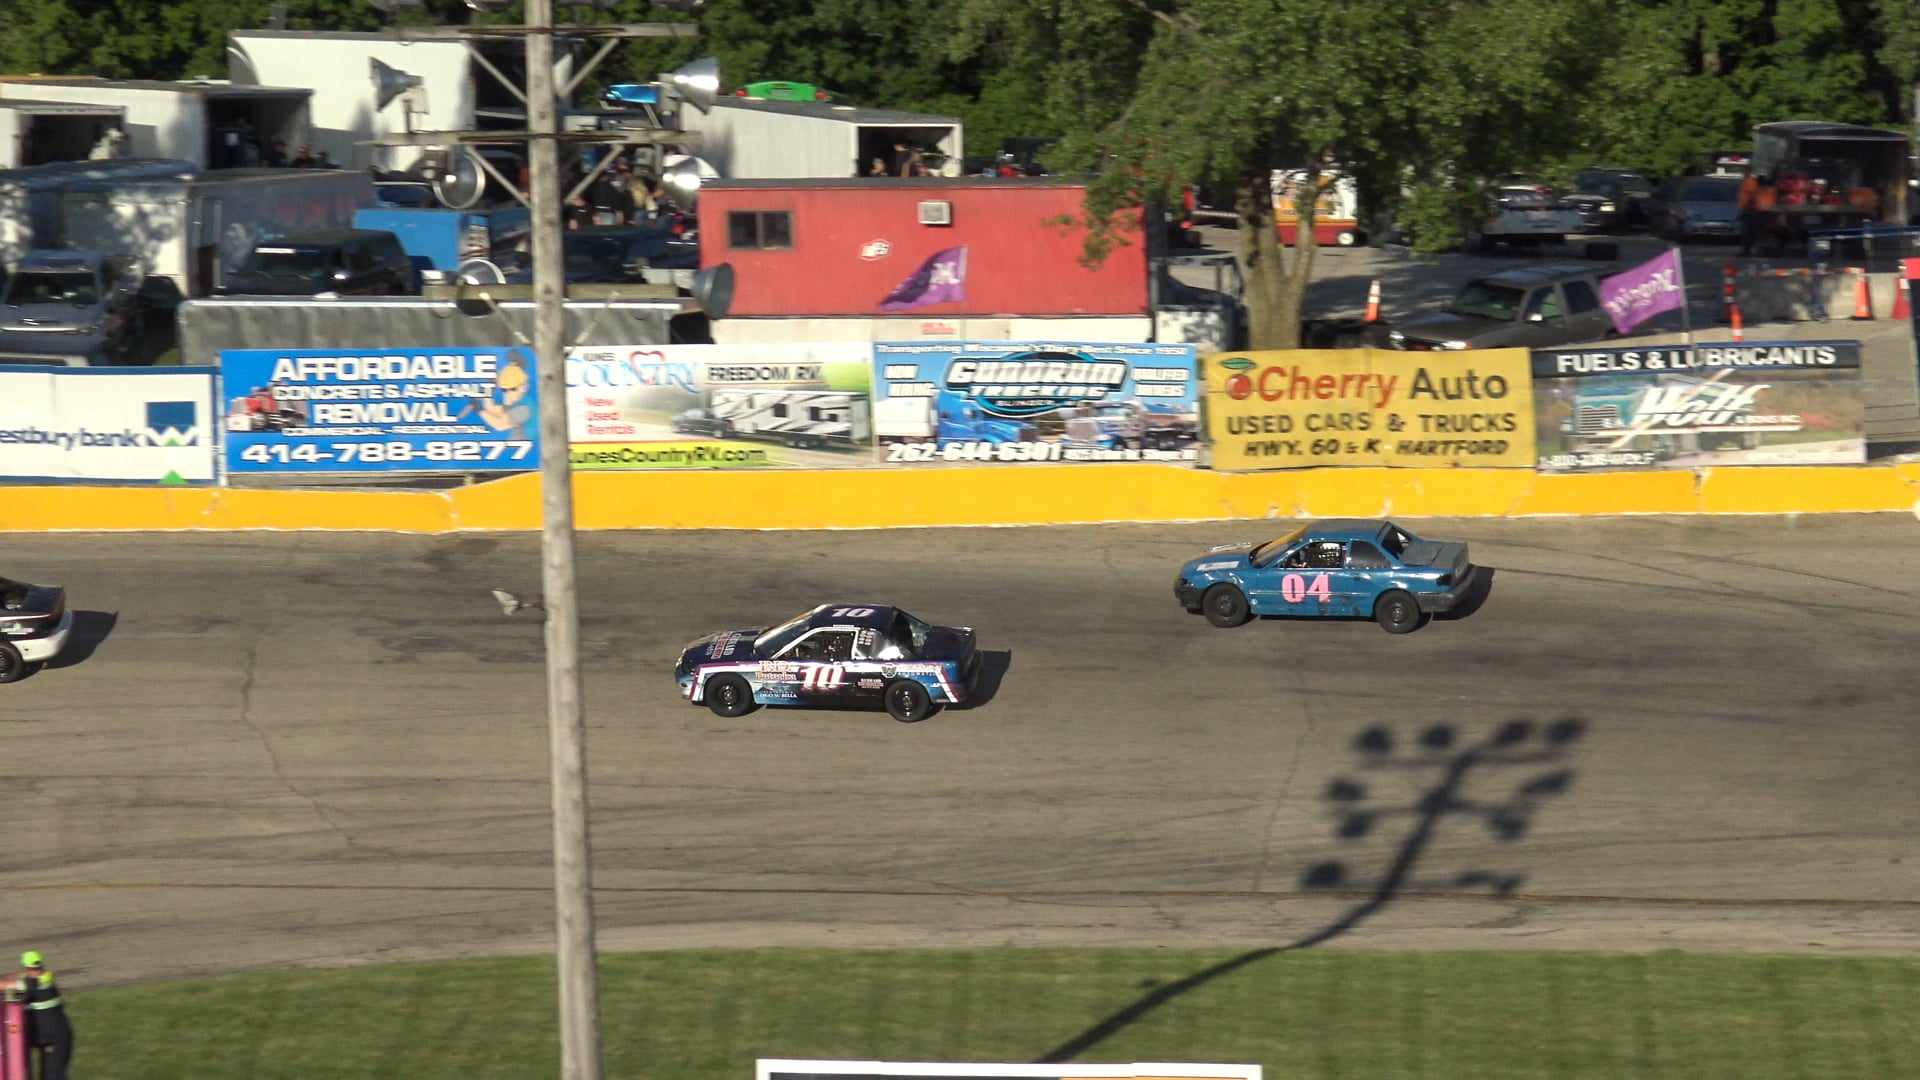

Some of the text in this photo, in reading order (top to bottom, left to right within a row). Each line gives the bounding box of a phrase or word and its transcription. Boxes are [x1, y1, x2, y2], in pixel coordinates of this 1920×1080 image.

[1114, 345, 1153, 355] Since
[1556, 346, 1838, 373] FUELS & LUBRICANTS
[272, 354, 497, 381] AFFORDABLE
[708, 364, 822, 382] FREEDOM RV
[274, 383, 496, 400] CONCRETE & ASPHALT
[1257, 365, 1509, 409] Cherry Auto
[584, 396, 615, 408] New
[312, 402, 459, 424] REMOVAL
[584, 410, 621, 422] Used
[585, 424, 636, 435] Rentals
[1226, 412, 1518, 435] USED CARS & TRUCKS
[79, 428, 143, 447] bank
[1311, 438, 1338, 456] 60
[1365, 438, 1383, 454] K
[1395, 439, 1511, 456] HARTFORD
[240, 440, 534, 464] 414-788-8277
[886, 441, 1063, 463] 262-644-6301
[1281, 573, 1331, 603] 04
[831, 608, 875, 617] 10
[798, 664, 846, 690] 10
